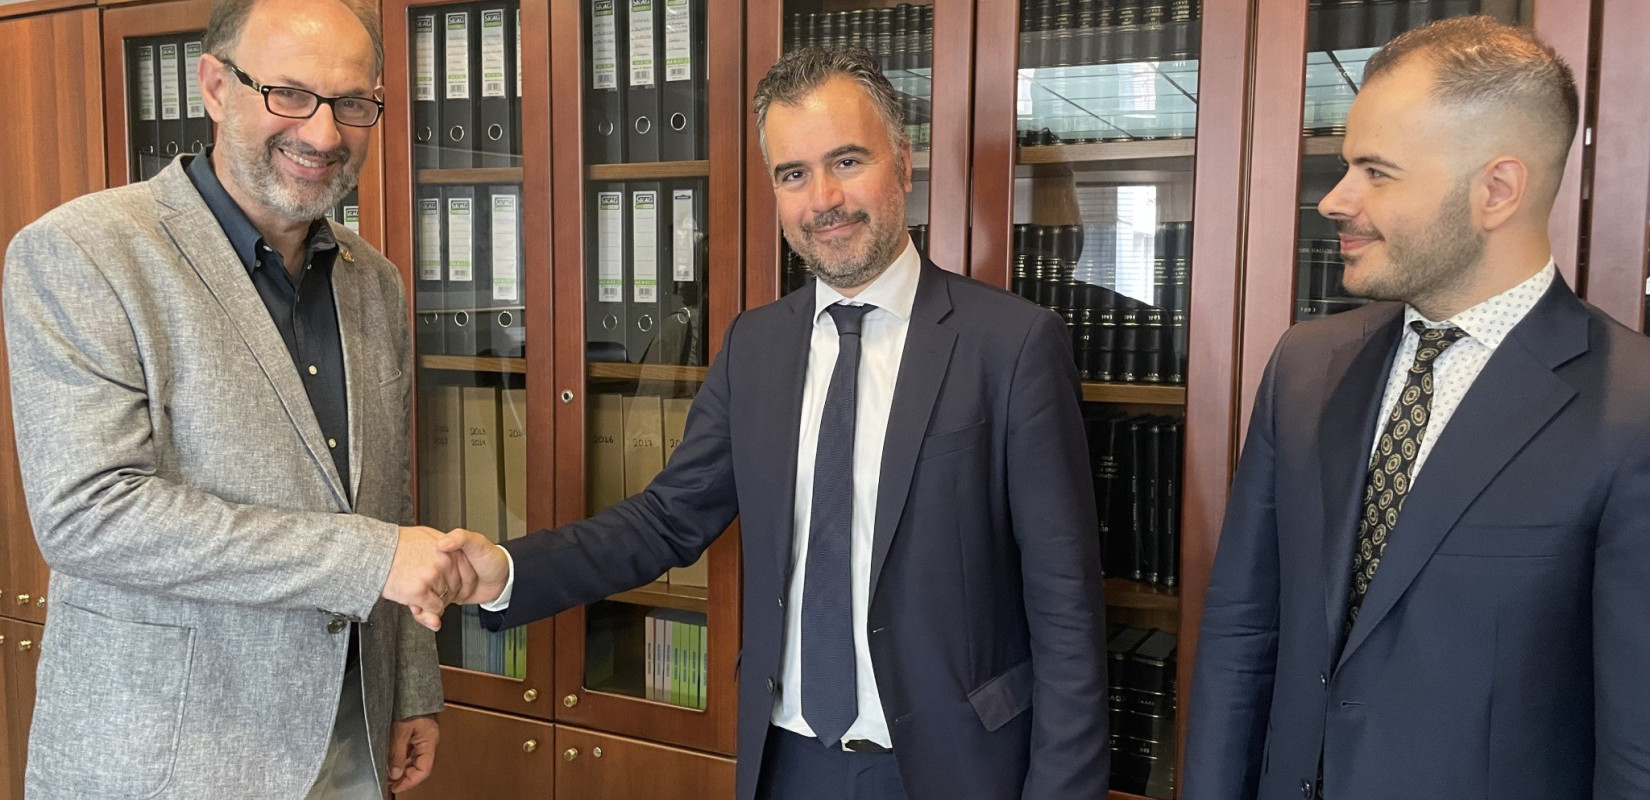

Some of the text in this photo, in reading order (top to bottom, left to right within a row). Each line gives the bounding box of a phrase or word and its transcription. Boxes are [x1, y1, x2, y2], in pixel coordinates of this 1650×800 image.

[449, 15, 465, 25] SKAG
[484, 12, 501, 21] SKAG
[495, 198, 513, 207] SKAG
[602, 195, 619, 205] SKAG
[636, 195, 654, 204] SKAG
[451, 201, 469, 209] SKAG
[470, 427, 487, 436] 2013
[592, 435, 614, 444] 2016
[632, 438, 653, 448] 2017
